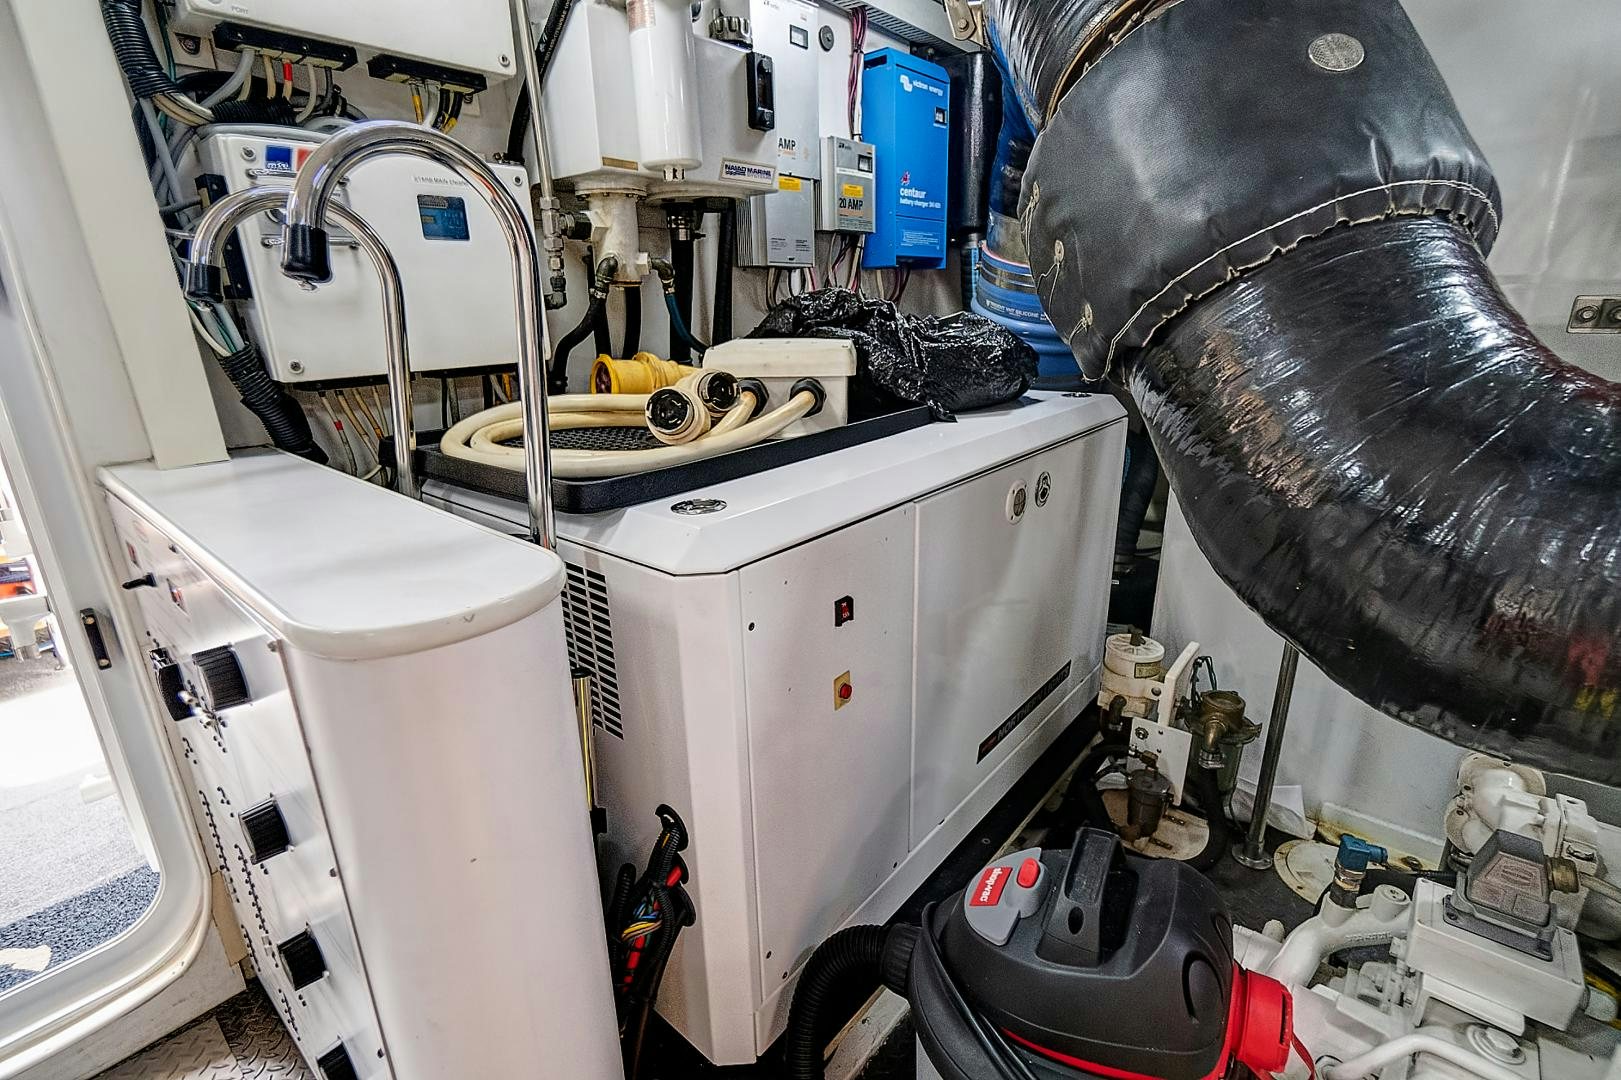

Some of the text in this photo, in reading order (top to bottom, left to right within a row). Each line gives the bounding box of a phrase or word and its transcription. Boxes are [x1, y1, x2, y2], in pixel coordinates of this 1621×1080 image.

[778, 137, 796, 151] AMP
[747, 168, 772, 177] MARINE
[900, 187, 927, 199] centaur
[838, 197, 863, 211] 20 AMP
[900, 197, 914, 207] battery
[914, 199, 929, 209] charger
[1015, 310, 1039, 318] SILICONE
